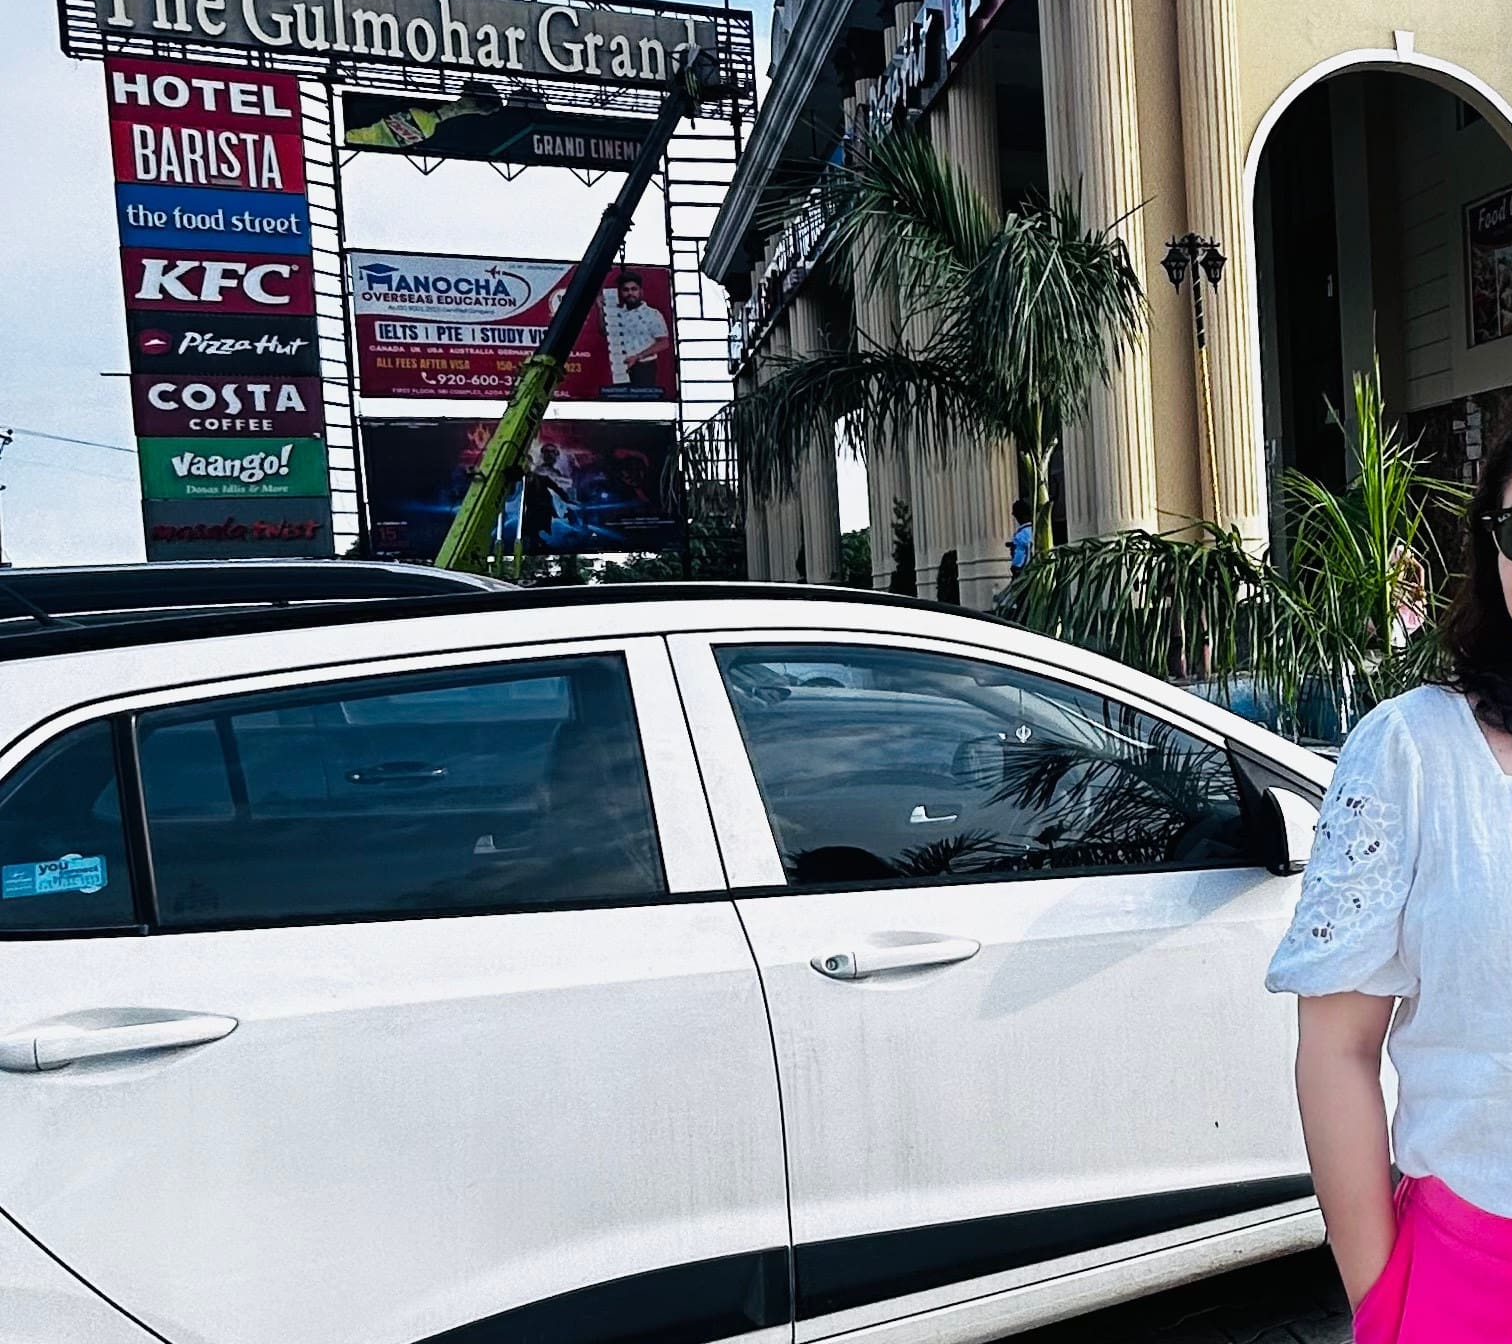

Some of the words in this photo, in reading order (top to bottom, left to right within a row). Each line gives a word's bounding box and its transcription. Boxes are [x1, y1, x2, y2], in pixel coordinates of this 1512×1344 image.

[112, 72, 292, 117] HOTEL
[132, 124, 283, 189] BARISTA
[533, 134, 585, 157] GRAND
[126, 204, 167, 227] the
[173, 207, 225, 231] food
[231, 211, 302, 234] street
[1478, 198, 1506, 231] Food
[135, 258, 292, 304] KFC
[366, 270, 511, 297] MANOCHA
[362, 292, 433, 304] OVERSEAS
[437, 295, 516, 307] EDUCATION
[178, 332, 252, 354] Pizza
[249, 334, 310, 355] Hut
[379, 323, 418, 340] IELTS
[437, 326, 463, 341] PTE
[481, 327, 524, 343] STUDY
[450, 347, 494, 355] AUSTRALIA
[376, 357, 393, 368] ALL
[395, 358, 417, 369] FEES
[420, 358, 447, 369] AFTER
[449, 359, 470, 370] VISA
[148, 382, 307, 415] COSTA
[189, 418, 273, 431] COFFEE
[261, 484, 289, 493] More
[38, 860, 69, 875] you
